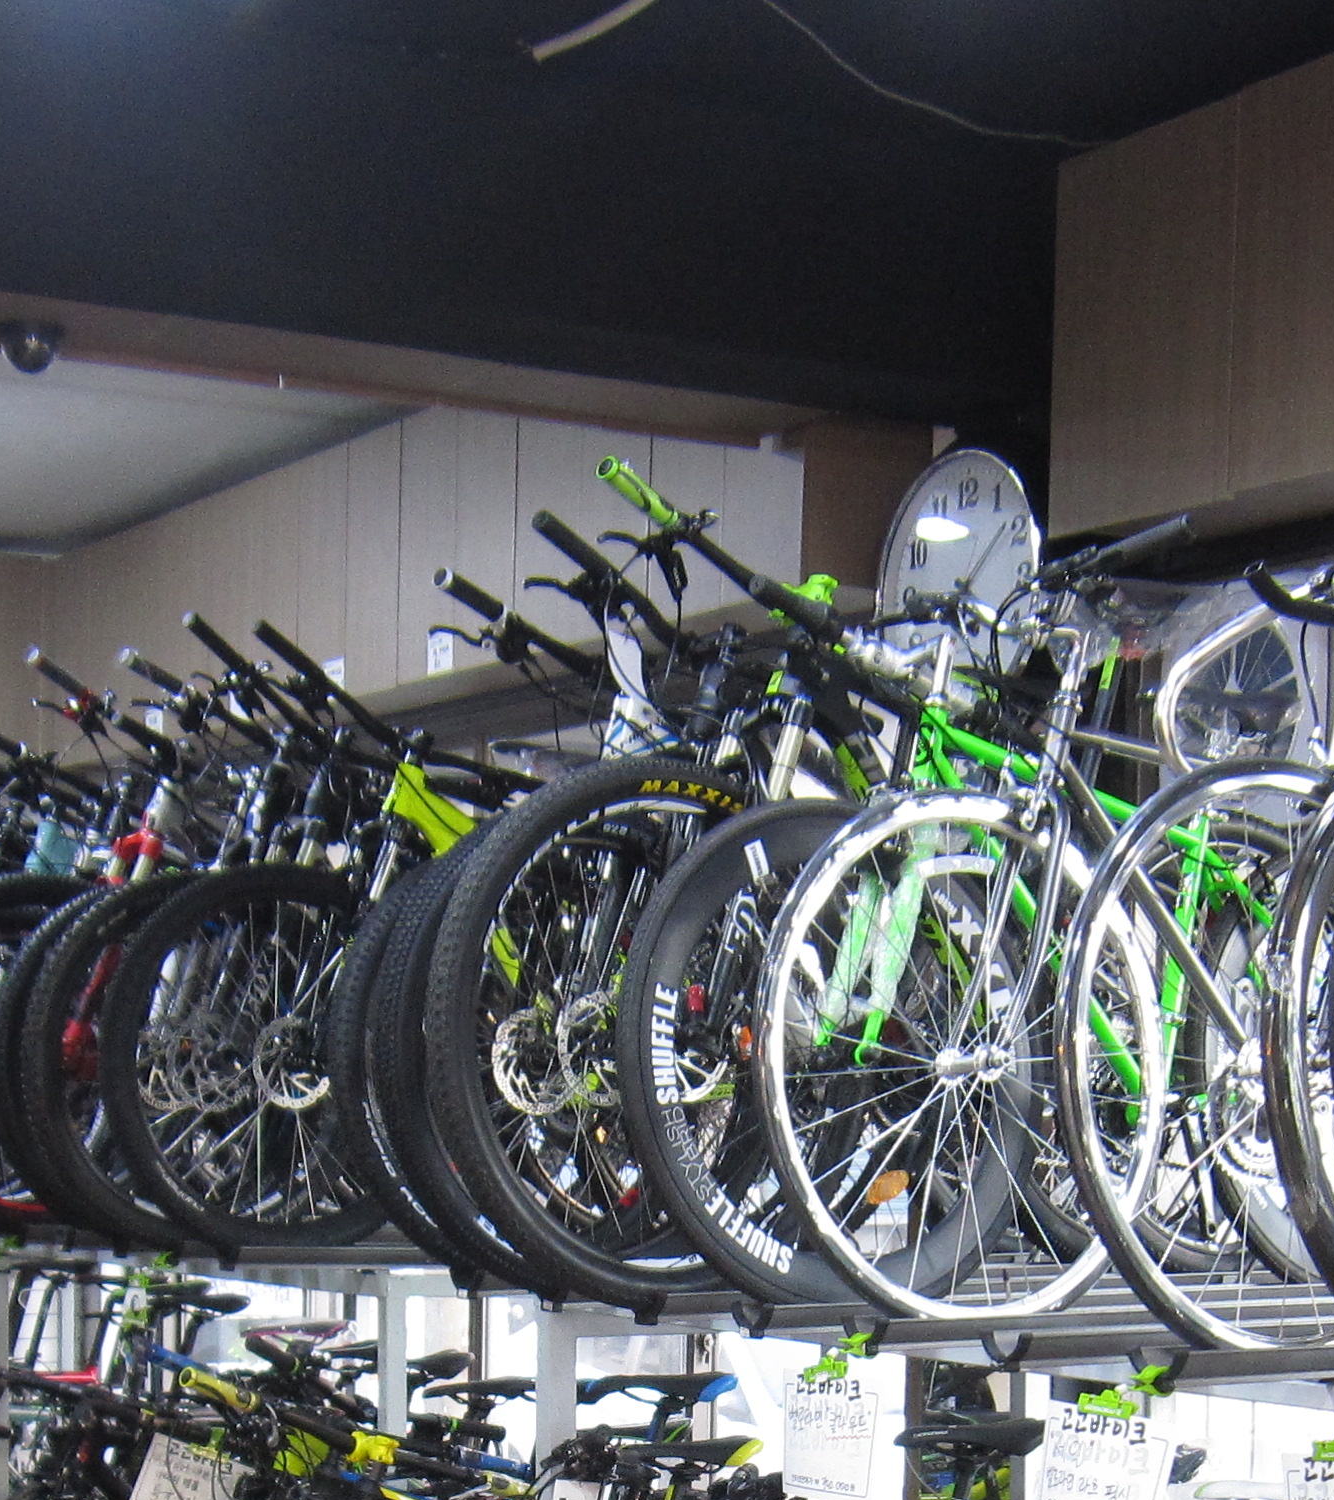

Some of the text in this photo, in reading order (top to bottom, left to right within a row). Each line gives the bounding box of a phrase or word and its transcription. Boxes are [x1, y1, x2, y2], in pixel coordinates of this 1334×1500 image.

[956, 477, 979, 511] 12
[992, 482, 1003, 513] 1
[1010, 514, 1028, 548] 2
[908, 538, 929, 571] 10
[650, 981, 679, 1105] SHUFFLE
[704, 1186, 794, 1275] SHUFFLE
